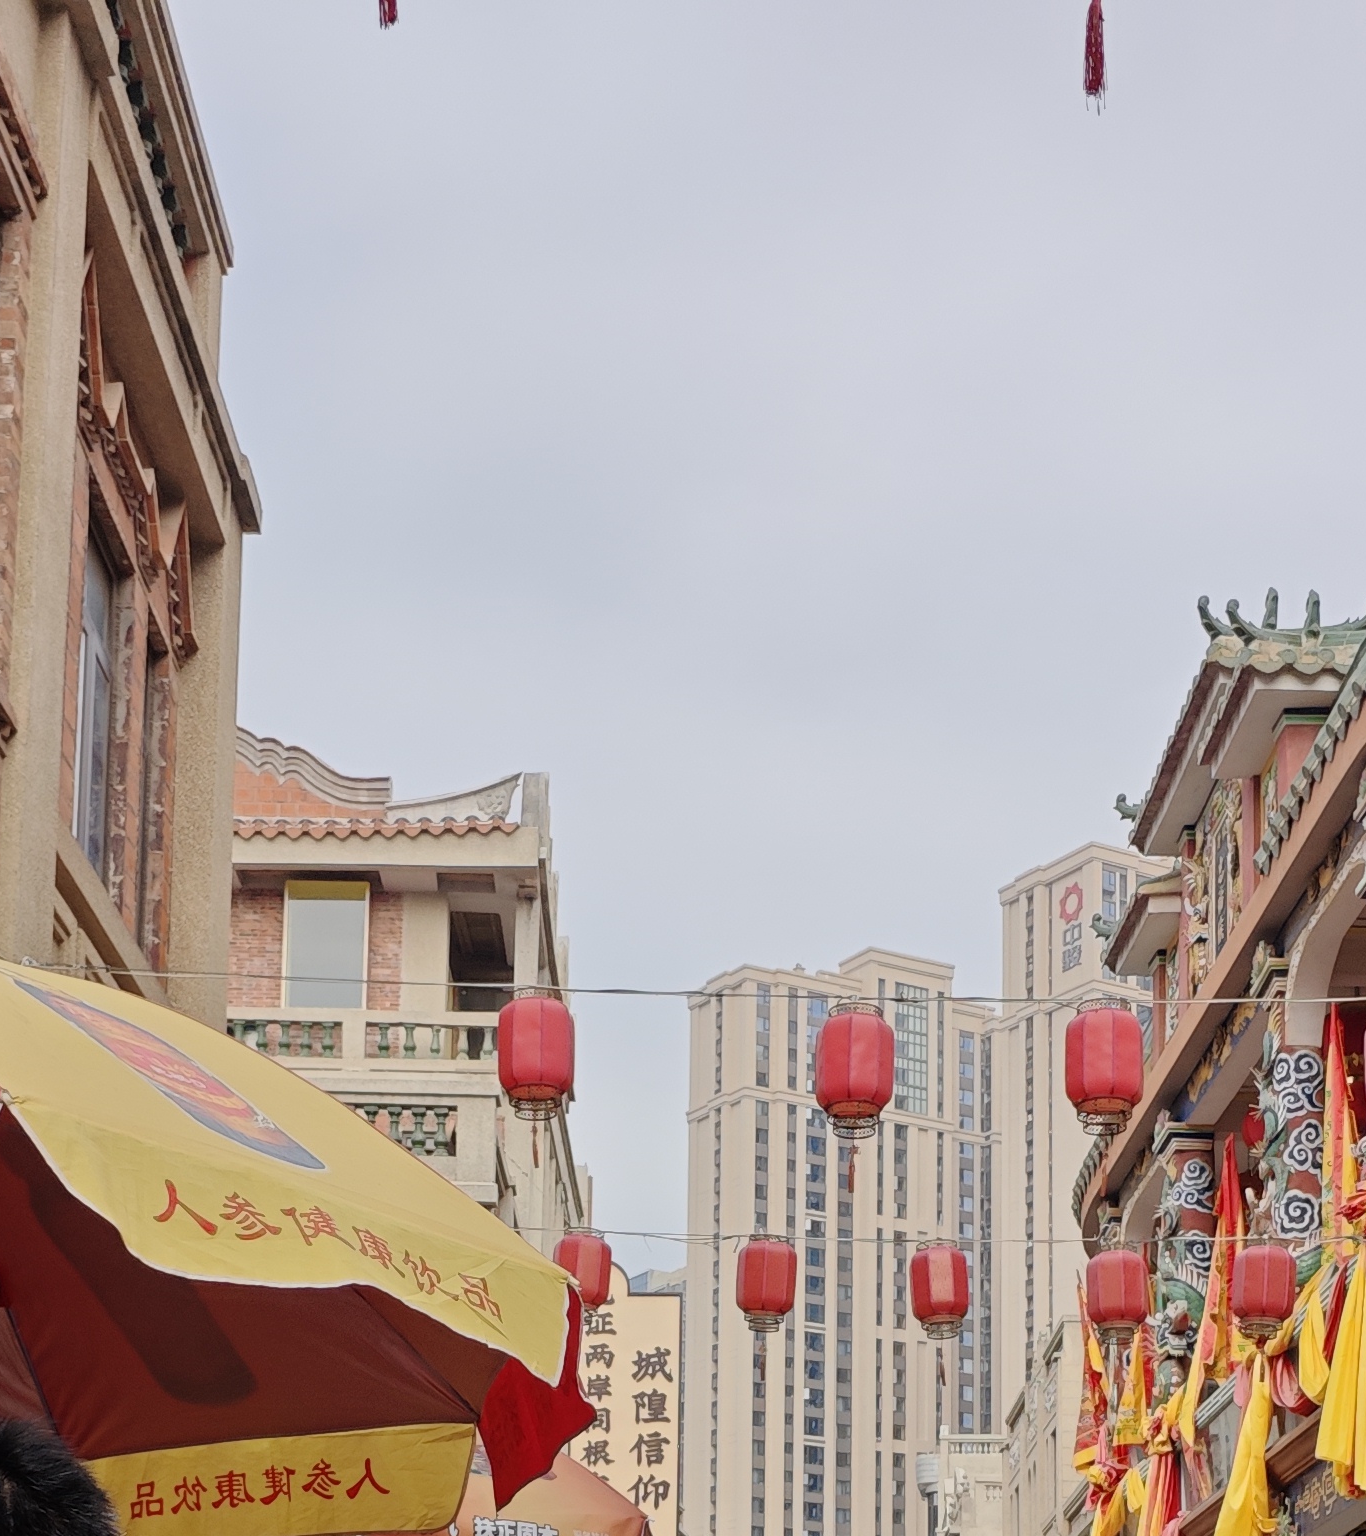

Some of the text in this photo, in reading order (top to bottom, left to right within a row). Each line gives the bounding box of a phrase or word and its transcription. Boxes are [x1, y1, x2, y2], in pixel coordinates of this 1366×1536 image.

[153, 1179, 505, 1340] 人参健康饮品
[629, 1346, 675, 1511] 城隍信仰
